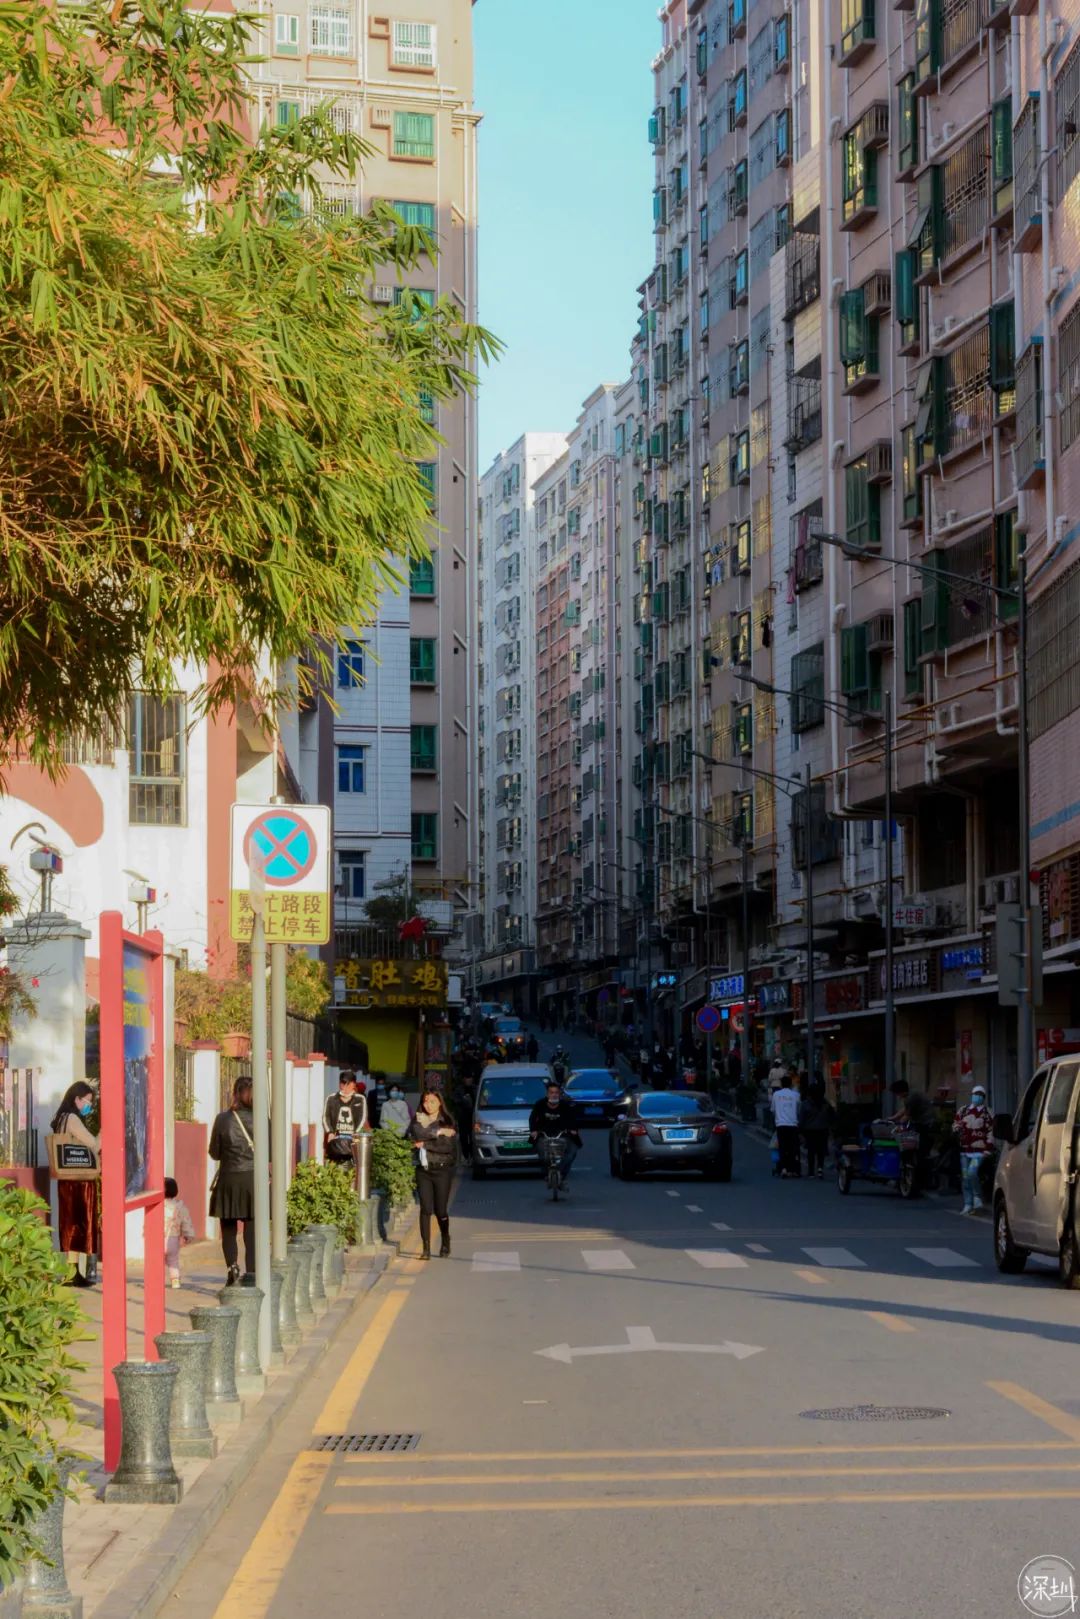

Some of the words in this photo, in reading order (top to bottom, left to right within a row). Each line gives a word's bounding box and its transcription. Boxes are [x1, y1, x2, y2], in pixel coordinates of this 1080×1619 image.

[238, 893, 321, 914] 繁忙路段
[238, 916, 321, 937] 禁止停车
[334, 960, 443, 992] 猪肚鸡
